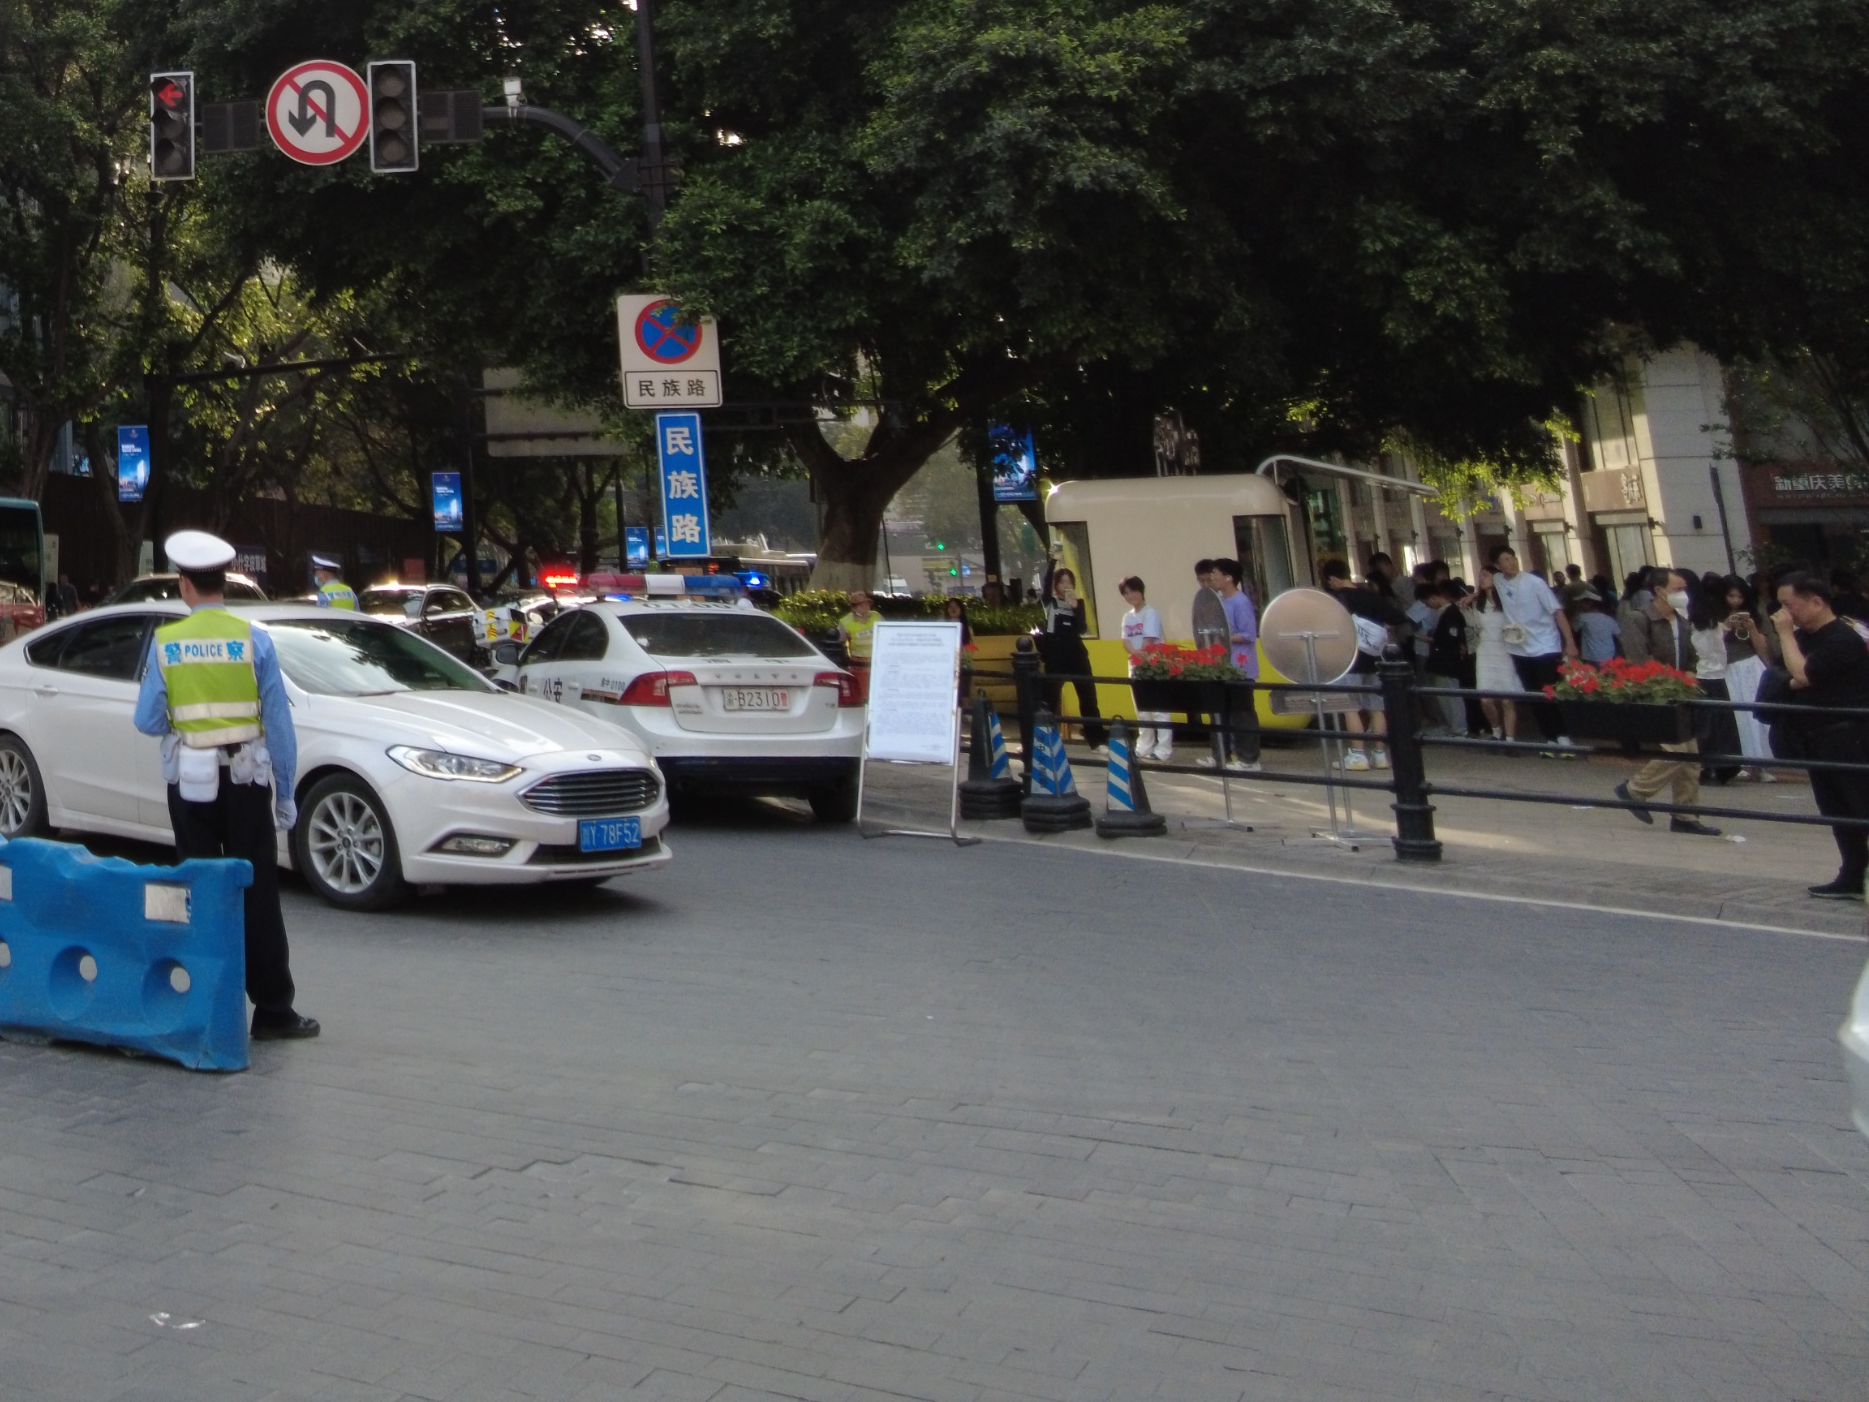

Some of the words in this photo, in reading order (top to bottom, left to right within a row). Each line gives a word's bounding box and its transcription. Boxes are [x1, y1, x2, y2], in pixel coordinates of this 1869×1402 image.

[638, 378, 706, 398] 民族路
[665, 426, 701, 544] 民族路
[164, 641, 181, 665] 警
[185, 644, 223, 658] POLICE
[226, 640, 244, 662] 察
[543, 678, 563, 703] 公安
